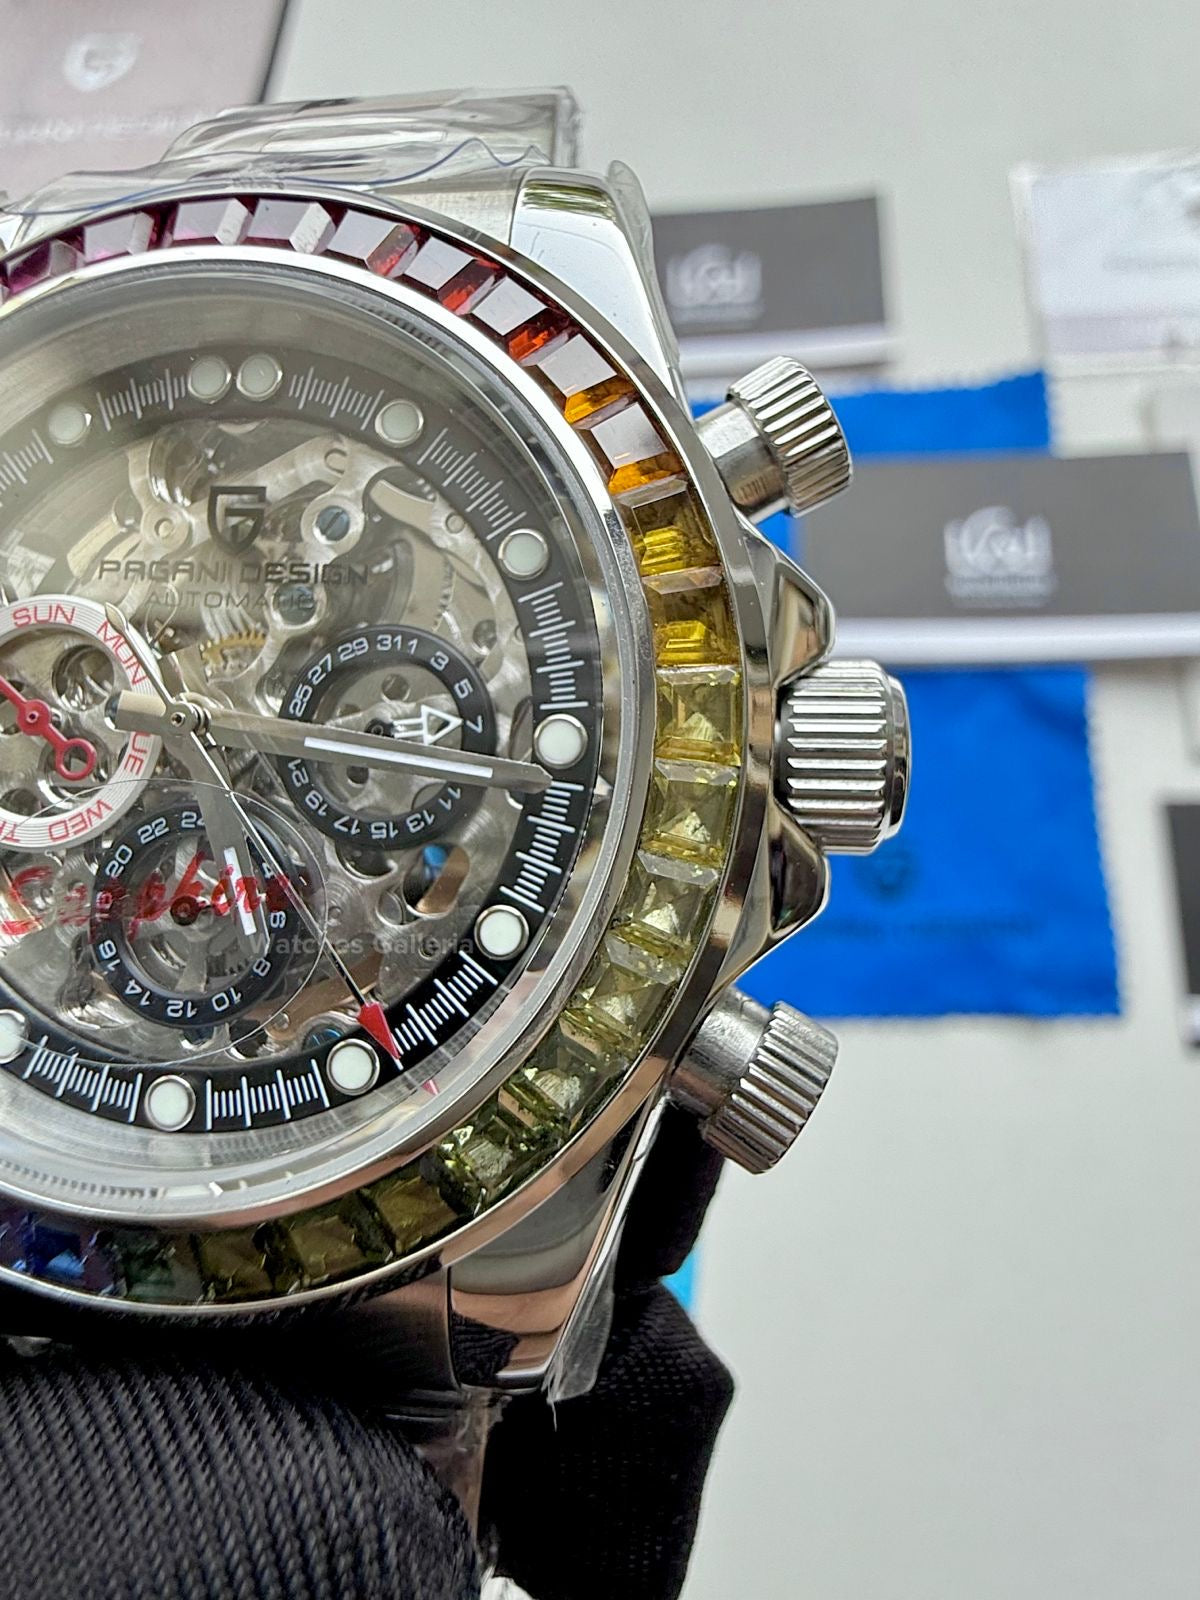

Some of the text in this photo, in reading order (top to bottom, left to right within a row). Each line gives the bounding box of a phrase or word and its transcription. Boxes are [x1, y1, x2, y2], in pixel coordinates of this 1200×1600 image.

[98, 560, 370, 585] PAGANI DESIGN
[12, 603, 77, 628] SUN
[96, 620, 149, 686] MON
[337, 637, 369, 662] 29
[376, 633, 403, 651] 31
[407, 638, 419, 655] 1
[307, 653, 334, 686] 27
[430, 650, 450, 672] 3
[288, 682, 313, 719] 25
[453, 678, 474, 699] 5
[465, 714, 484, 734] 7
[287, 758, 309, 788] 21
[304, 790, 329, 817] 19
[438, 786, 461, 811] 11
[48, 798, 113, 842] WED
[137, 816, 170, 846] 22
[180, 810, 206, 829] 2
[333, 814, 361, 836] 17
[370, 821, 399, 840] 15
[406, 809, 435, 834] 13
[104, 844, 133, 879] 20
[98, 938, 121, 972] 16
[252, 956, 273, 978] 8
[124, 977, 154, 1007] 14
[211, 985, 244, 1013] 10
[165, 998, 199, 1019] 12
